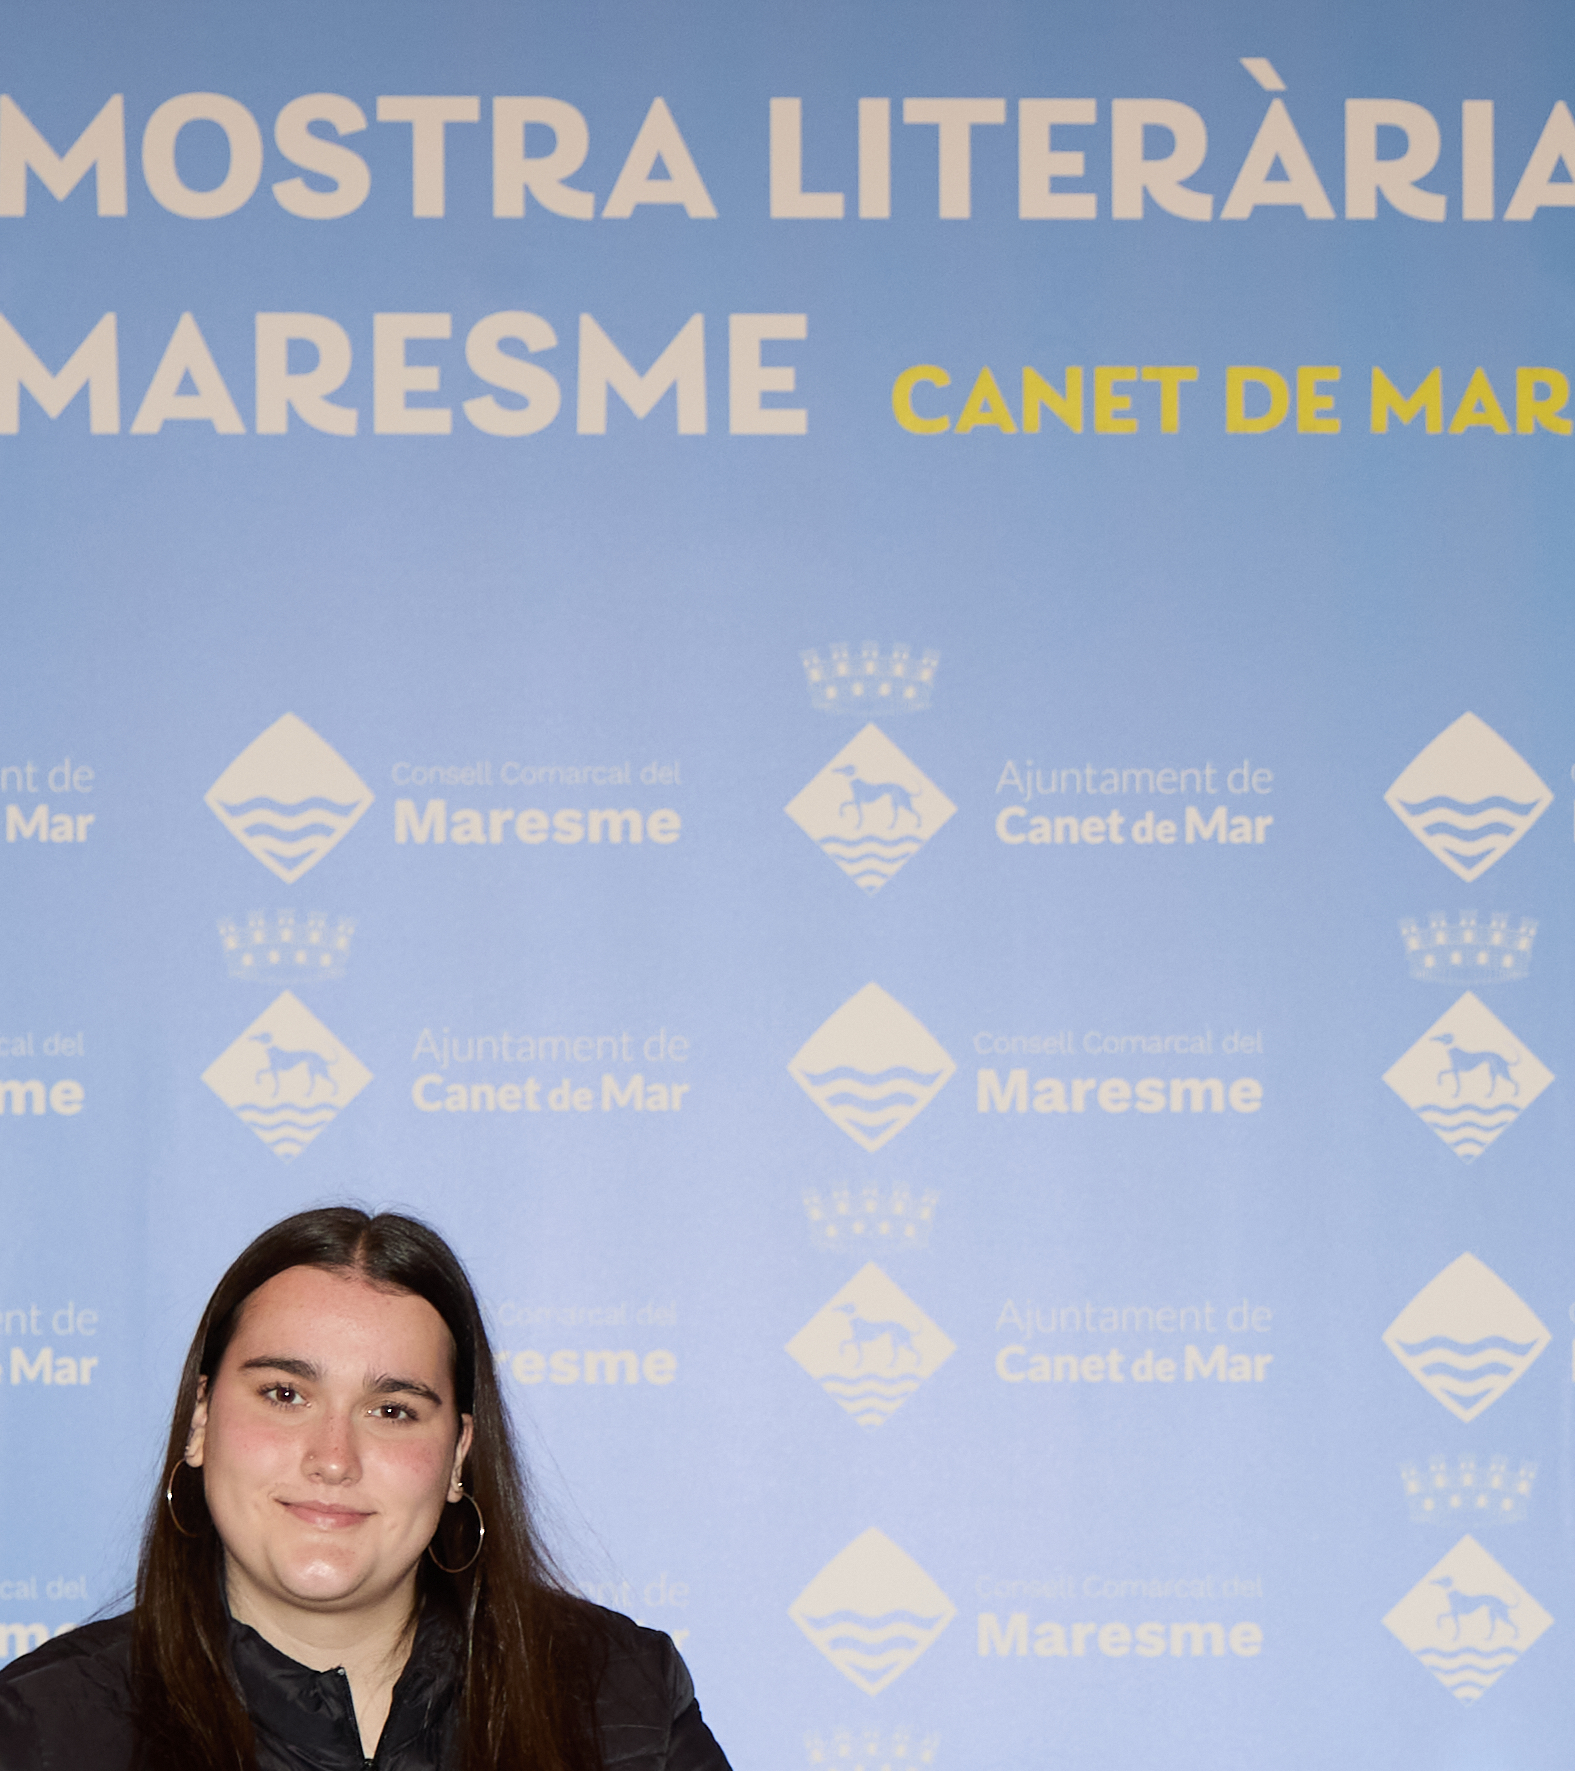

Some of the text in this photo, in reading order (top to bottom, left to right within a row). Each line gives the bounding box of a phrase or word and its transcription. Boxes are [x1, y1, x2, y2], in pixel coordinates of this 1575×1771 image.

[893, 365, 1197, 433] CANET
[1227, 367, 1340, 433] DE
[1372, 368, 1572, 434] MAR
[46, 758, 93, 793] de
[391, 761, 681, 786] Consell Comarcal del
[996, 760, 1273, 802] Ajuntament de
[7, 805, 94, 842] Mar
[395, 799, 681, 844] Maresme
[996, 806, 1273, 844] Canet de Mar
